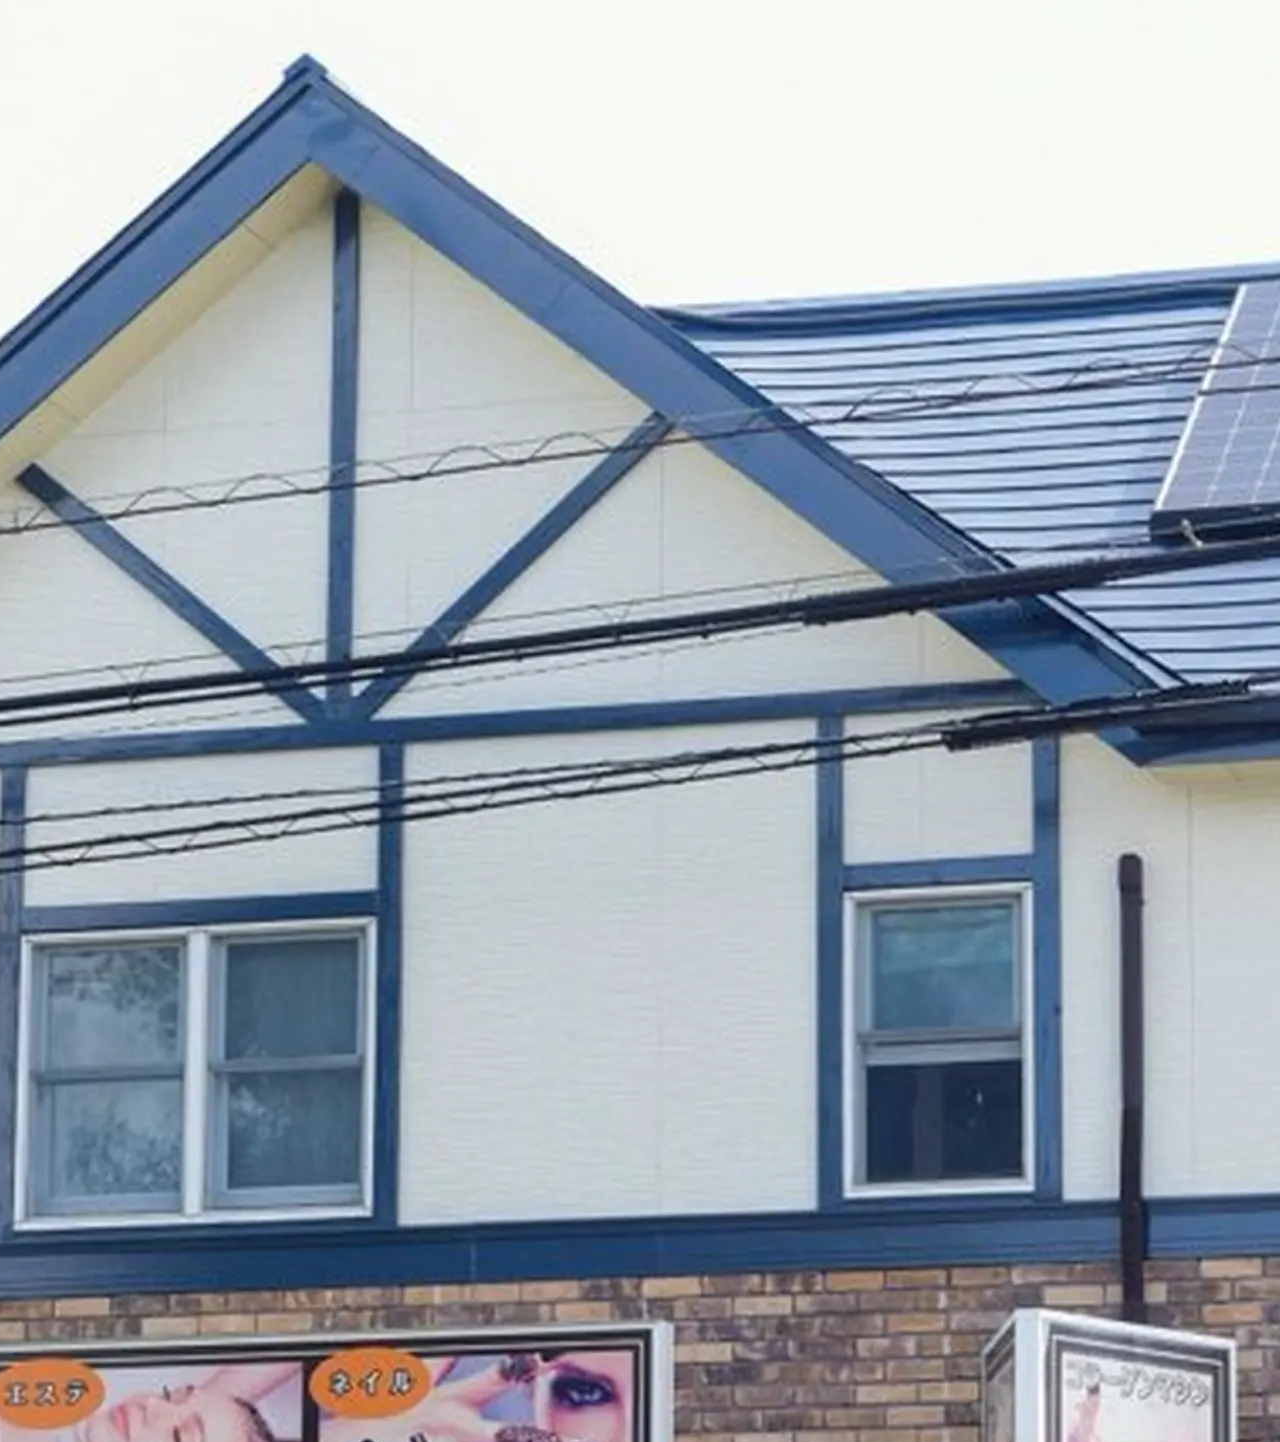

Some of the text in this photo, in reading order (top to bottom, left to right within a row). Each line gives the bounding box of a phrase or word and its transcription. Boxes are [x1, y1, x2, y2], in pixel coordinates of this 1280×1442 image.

[3, 1380, 89, 1407] エステ
[328, 1367, 414, 1397] ネイル
